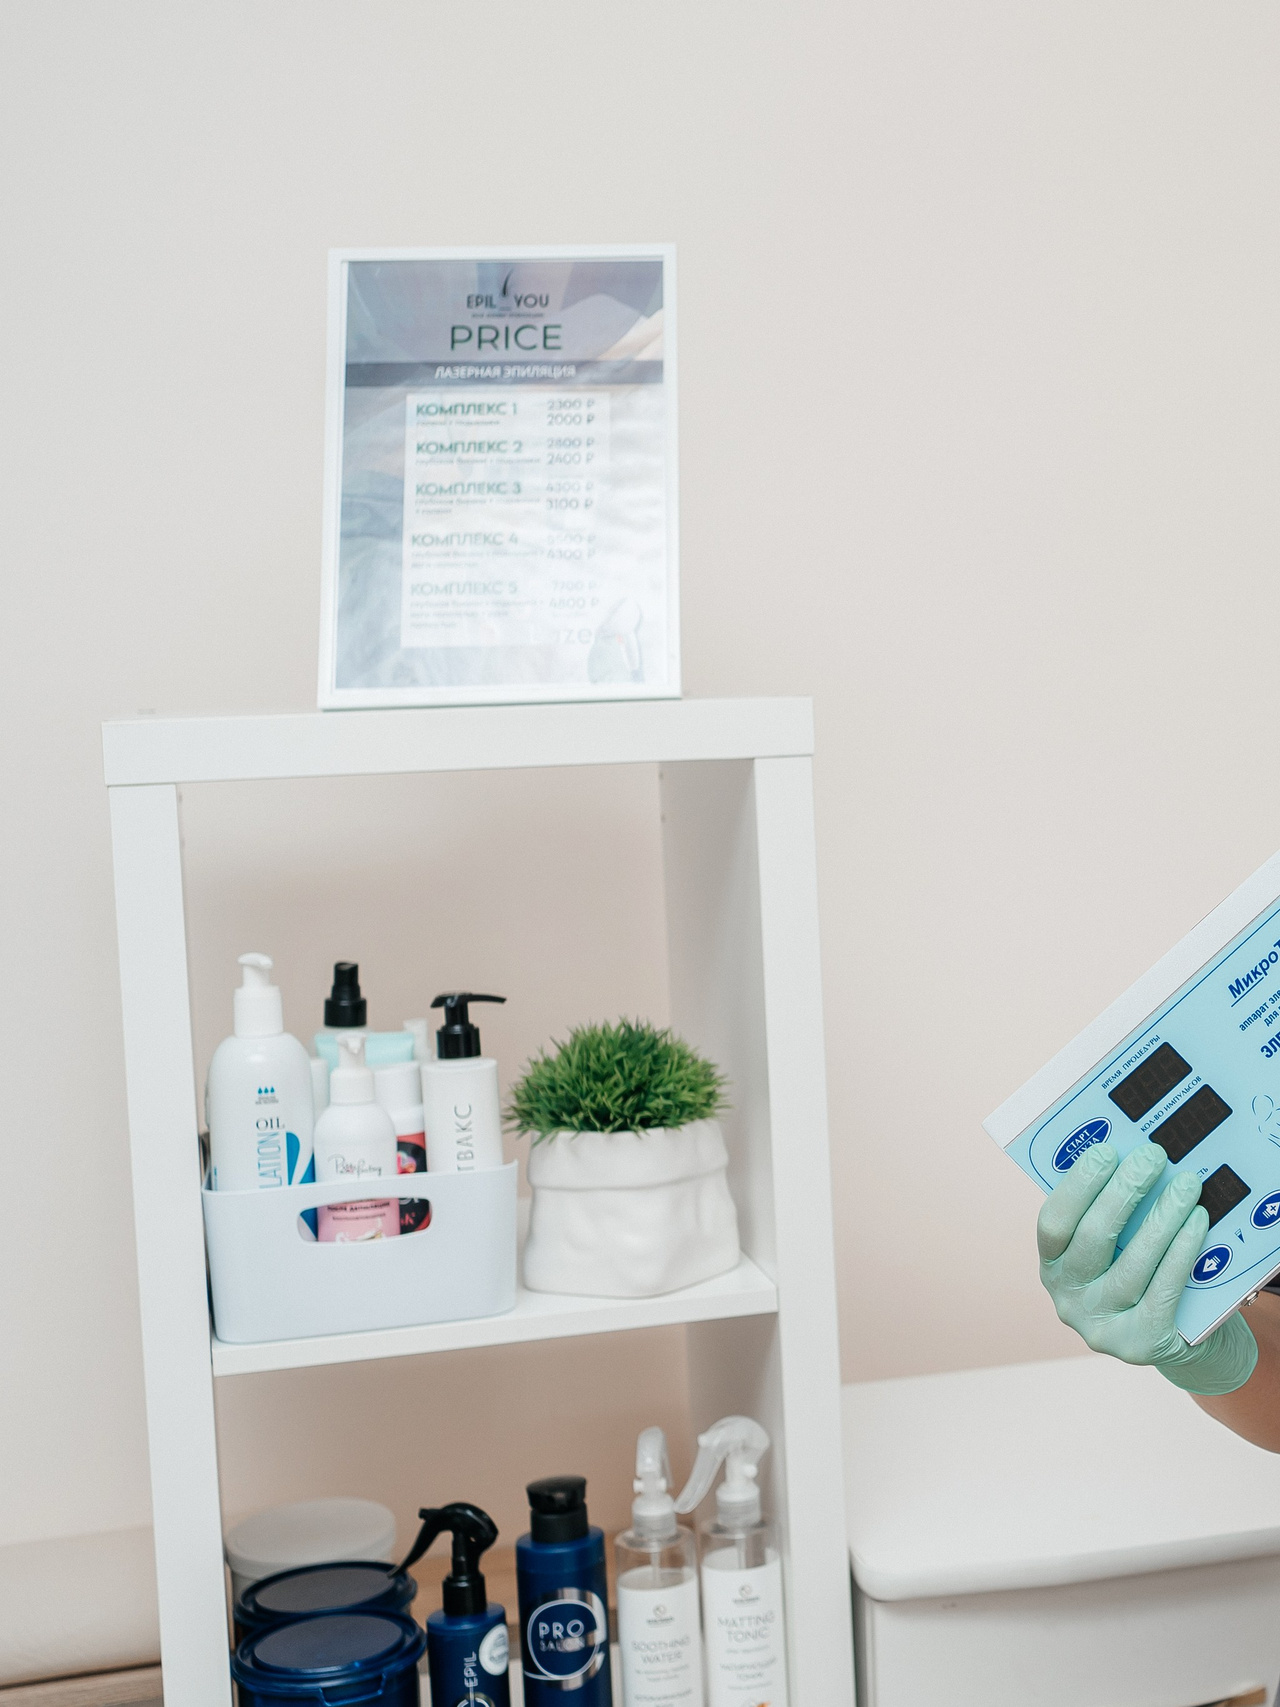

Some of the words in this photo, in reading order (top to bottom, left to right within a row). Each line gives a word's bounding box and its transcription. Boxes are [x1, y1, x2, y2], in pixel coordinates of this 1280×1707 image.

[467, 294, 497, 309] EPIL
[514, 294, 549, 308] YOU
[451, 324, 562, 351] PRICE
[434, 365, 501, 379] ЛАЗЕРНАЯ
[503, 365, 577, 379] ЭПИЛЯЦИЯ
[416, 402, 507, 417] КОМПЛЕКС
[512, 403, 518, 416] 1
[547, 413, 581, 426] 2000
[416, 440, 508, 455] КОМПЛЕКС
[511, 440, 523, 453] 2
[416, 482, 507, 496] КОМПЛЕКС
[513, 481, 521, 494] 3
[1239, 1001, 1270, 1032] аппарат
[1263, 1011, 1280, 1027] для
[1101, 1070, 1122, 1090] ВРЕМЯ
[1122, 1035, 1161, 1070] ПРОЦЕДУРЫ
[1140, 1110, 1165, 1133] КОЛ-ВО
[1163, 1076, 1202, 1112] ИМПУЛЬСОВ
[256, 1117, 285, 1131] OIL
[1065, 1129, 1090, 1153] СТАРТ
[539, 1619, 585, 1639] PRO
[727, 1626, 769, 1644] TONIC
[463, 1651, 478, 1688] EPIL
